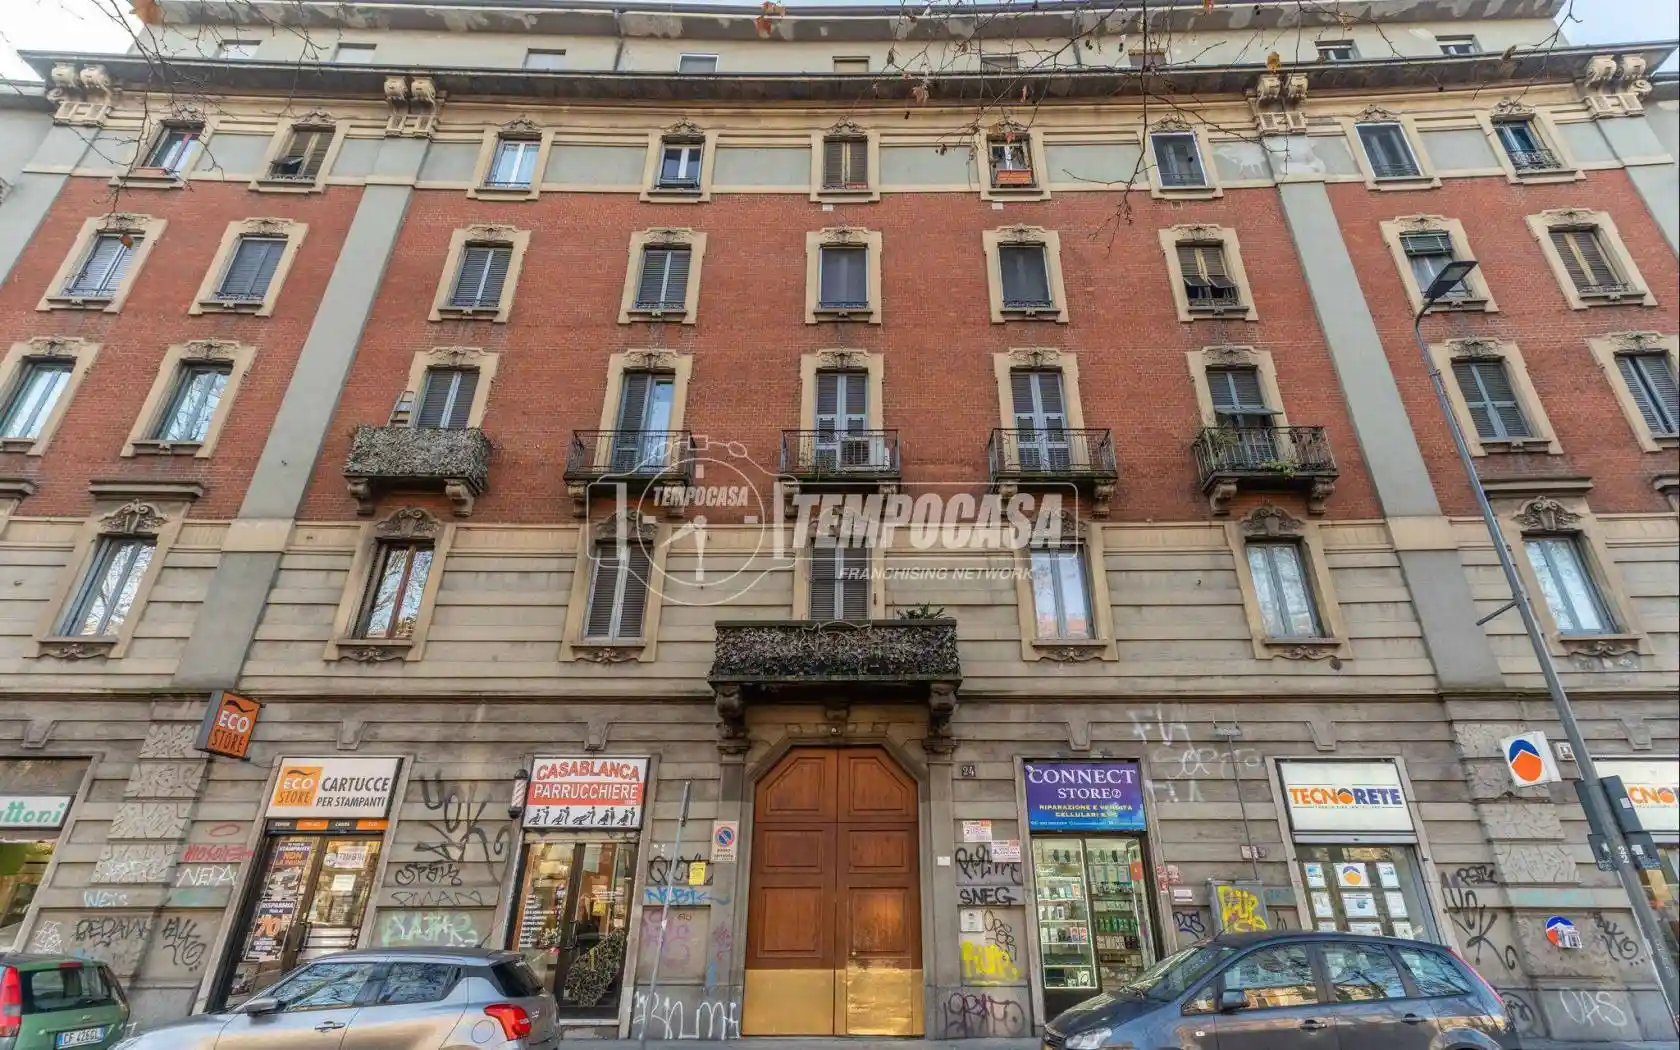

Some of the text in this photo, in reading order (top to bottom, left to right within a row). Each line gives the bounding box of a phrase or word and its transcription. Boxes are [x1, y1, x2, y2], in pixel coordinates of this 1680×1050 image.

[218, 710, 250, 733] ECO
[211, 728, 246, 752] STORE
[536, 760, 640, 781] CASABLANCA
[1028, 768, 1136, 784] CONNECT
[283, 777, 314, 790] ECO
[321, 777, 391, 792] CARTUCCE
[533, 783, 639, 800] PARRUCCHIERE
[278, 790, 311, 804] STORE
[315, 796, 386, 808] PER STAMPANTI
